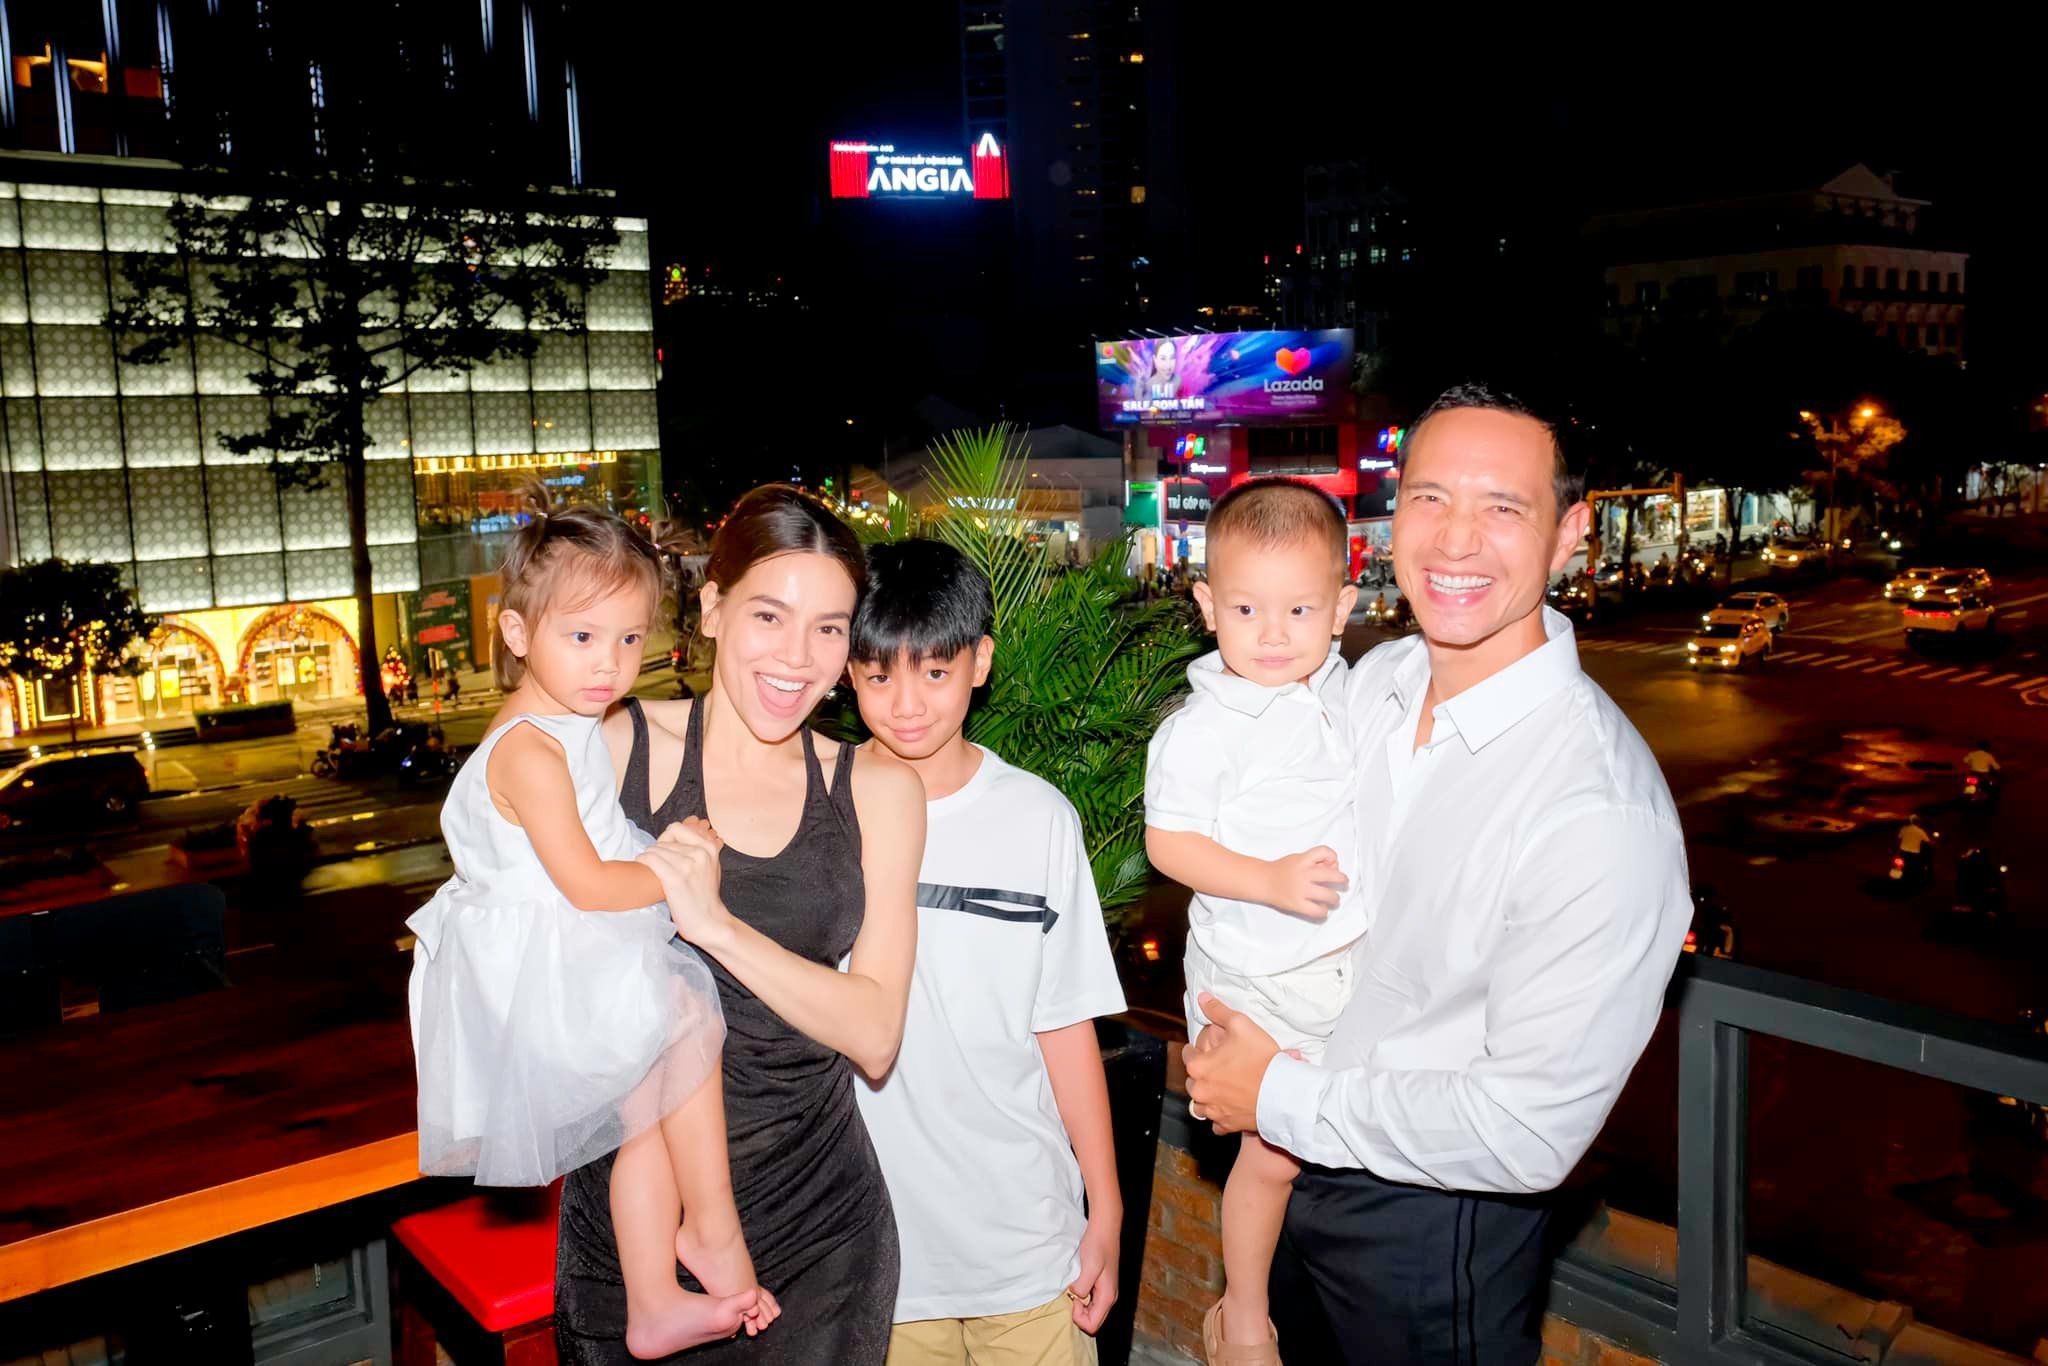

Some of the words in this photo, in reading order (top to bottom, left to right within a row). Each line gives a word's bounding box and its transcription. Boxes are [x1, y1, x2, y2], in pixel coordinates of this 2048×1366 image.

[867, 167, 974, 192] ANGIA
[1264, 375, 1324, 393] Lazada
[1122, 400, 1150, 411] SALE
[1180, 395, 1205, 410] TẤN
